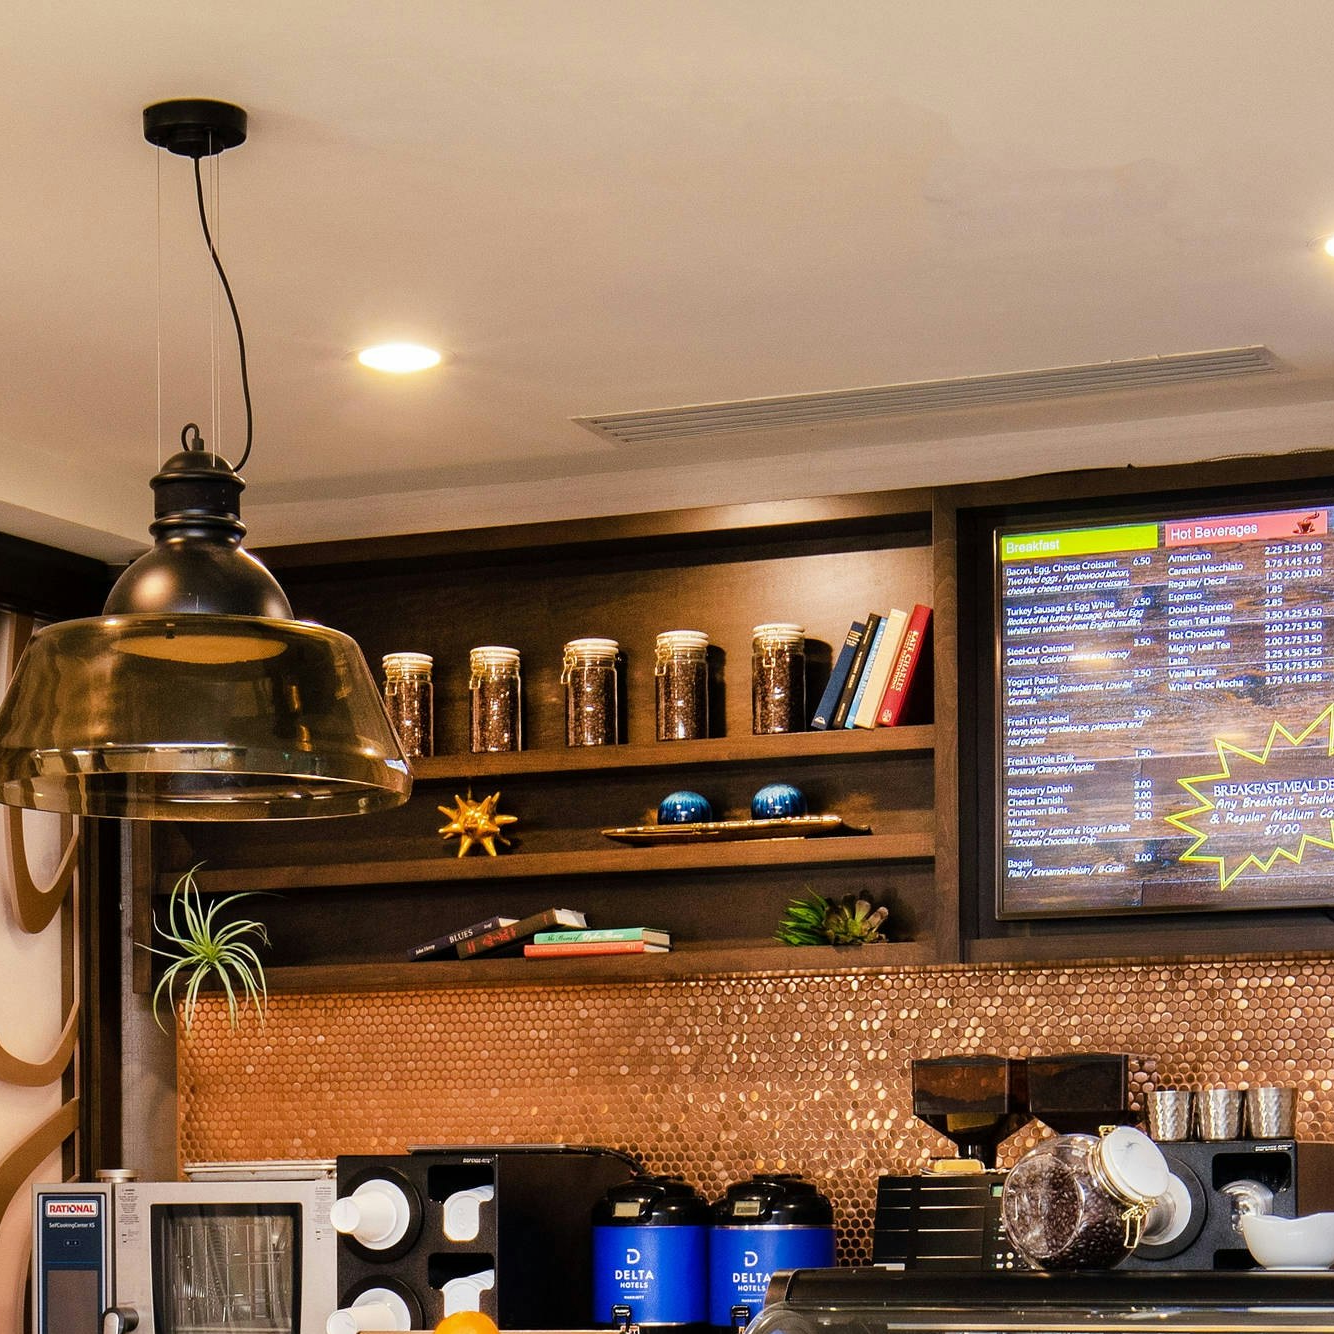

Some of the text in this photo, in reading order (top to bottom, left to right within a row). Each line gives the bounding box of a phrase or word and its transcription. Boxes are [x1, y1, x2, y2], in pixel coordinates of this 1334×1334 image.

[1171, 524, 1258, 540] Hot Beverages
[1006, 540, 1059, 553] Breakfast
[1168, 553, 1211, 563] Americano
[895, 630, 919, 692] KATE CHARLES
[1214, 782, 1281, 797] BREAKFAST
[1283, 780, 1315, 793] MEAL
[1216, 799, 1237, 810] Any
[1243, 795, 1294, 808] Breakfast
[1210, 814, 1219, 824] &
[1225, 811, 1266, 825] Regular
[1271, 809, 1314, 821] Medium
[448, 928, 474, 944] BLUES
[49, 1204, 94, 1213] RATIONAL
[615, 1270, 655, 1280] DELTA
[733, 1273, 771, 1283] DELTA
